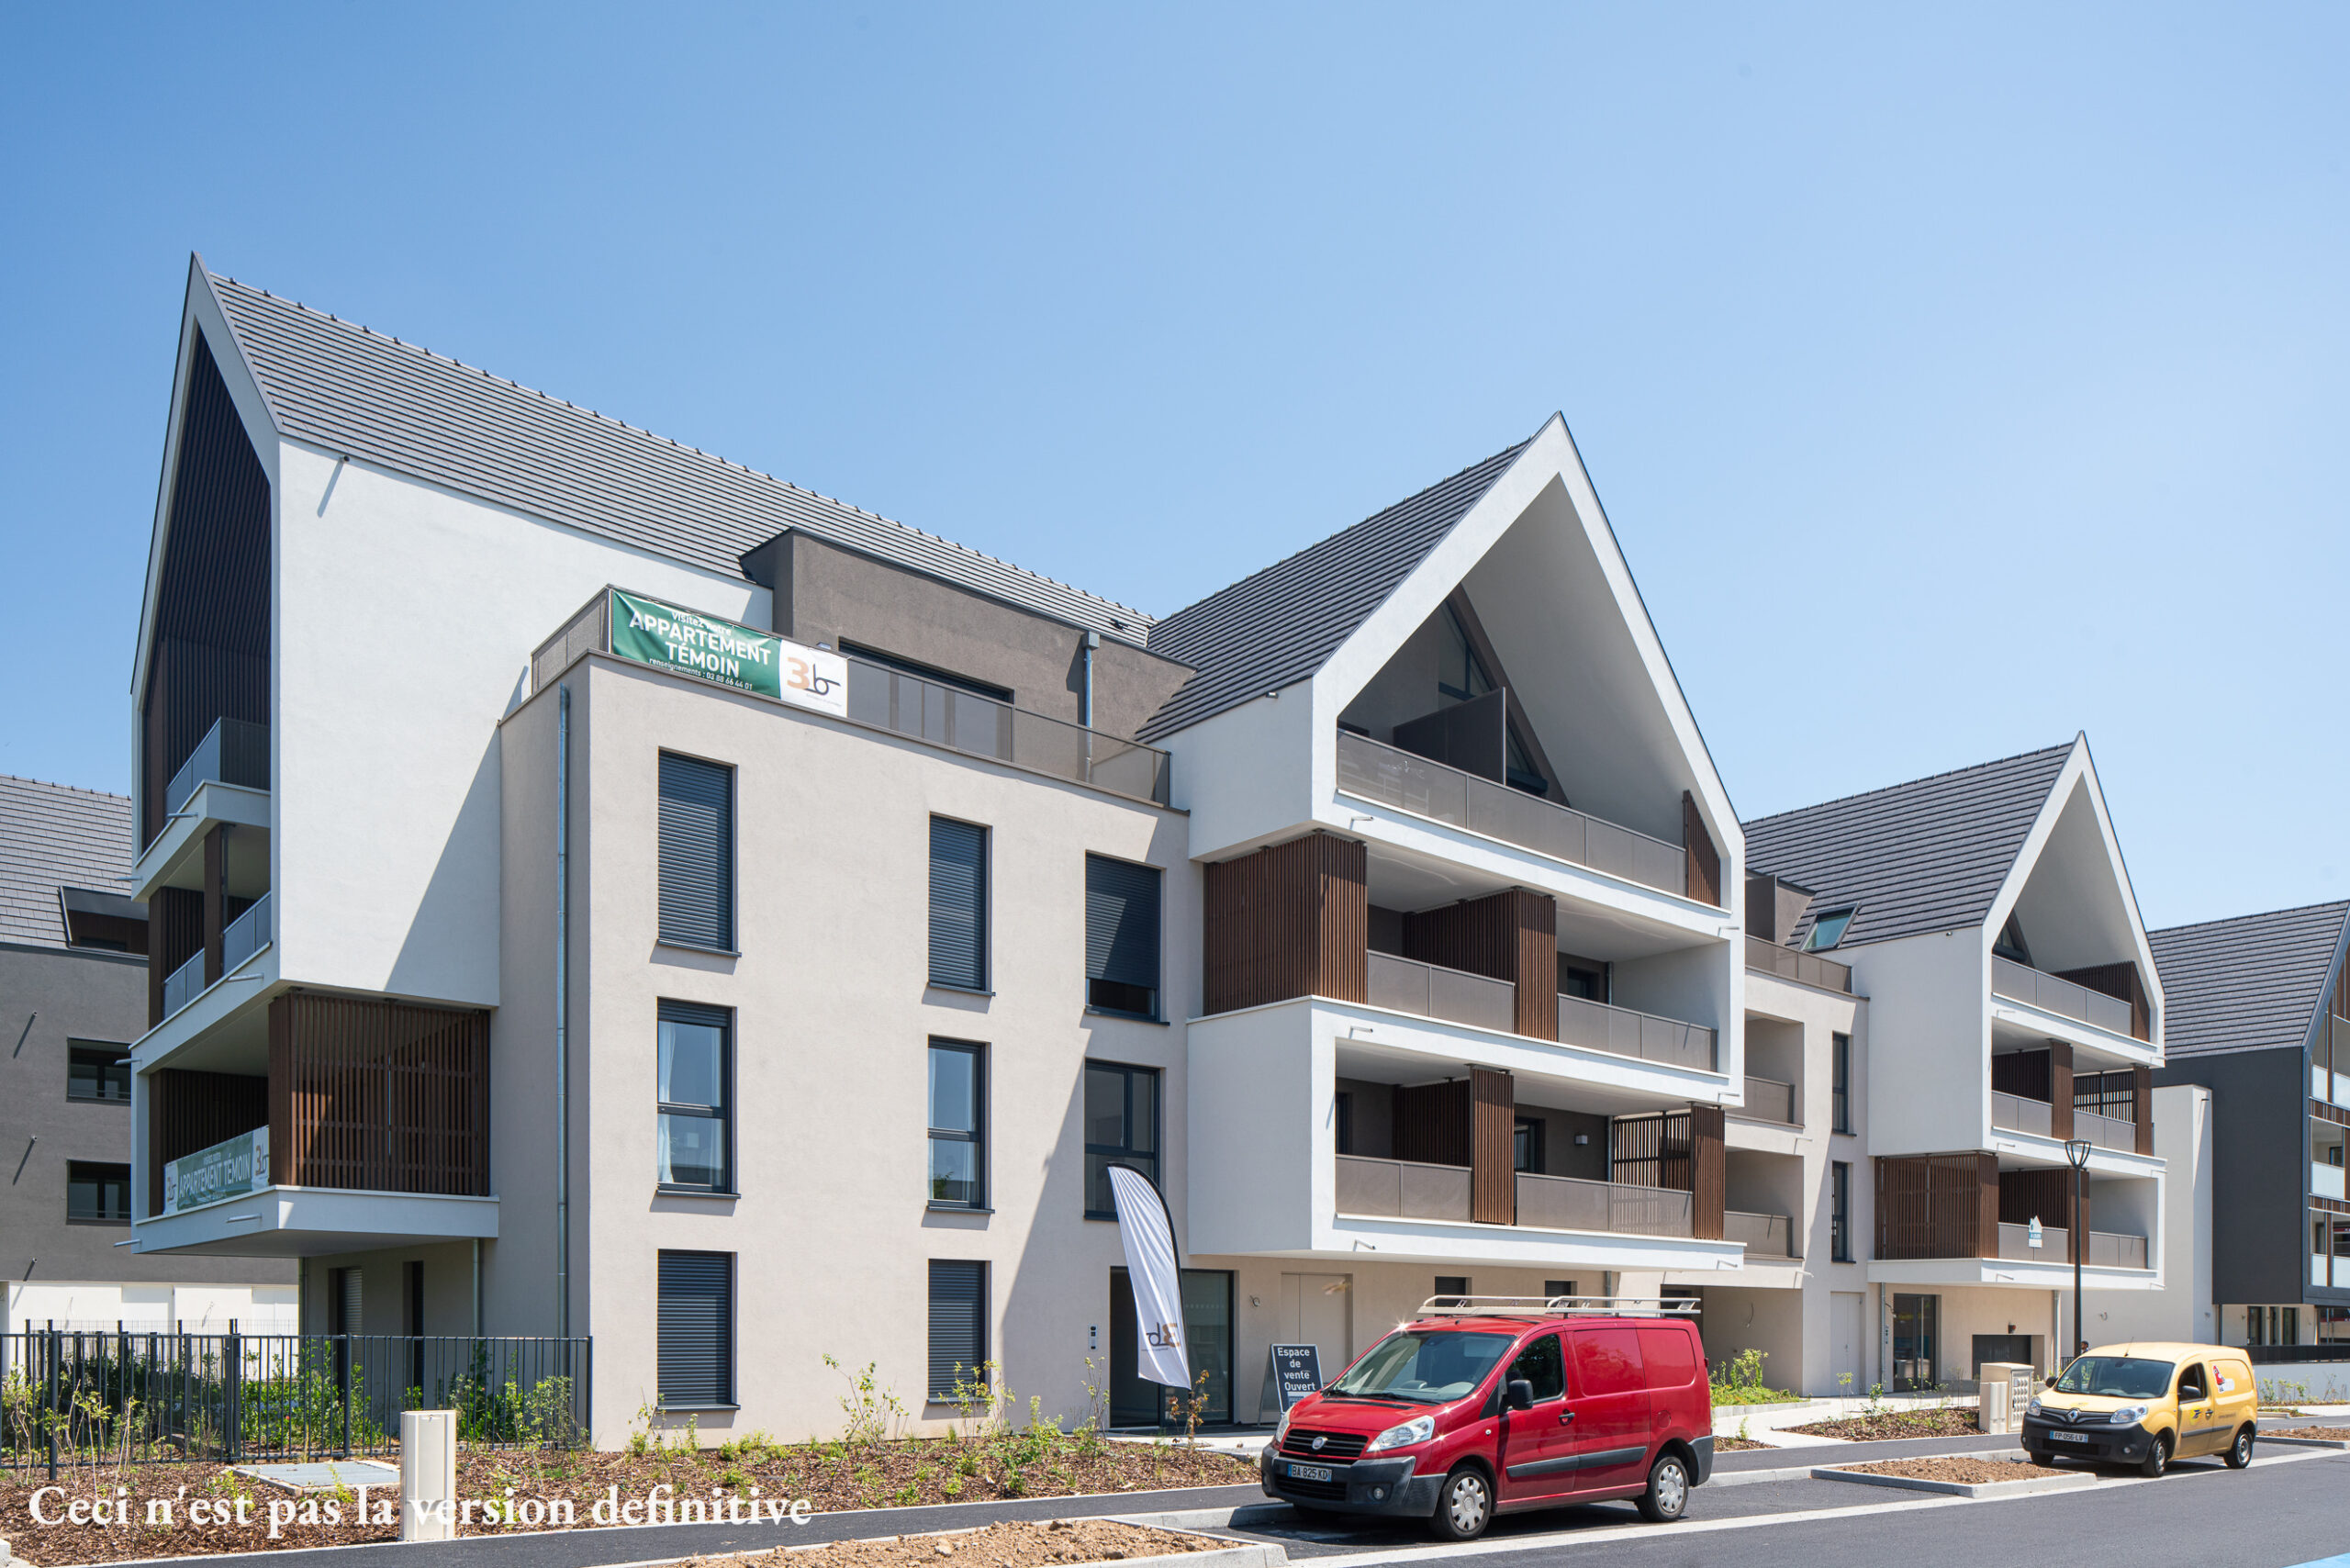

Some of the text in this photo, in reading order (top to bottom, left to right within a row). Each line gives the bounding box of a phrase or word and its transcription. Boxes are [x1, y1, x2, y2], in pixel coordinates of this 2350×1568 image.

[629, 610, 772, 666] APPARTEMENT
[665, 641, 740, 678] TÉMOIN
[649, 658, 701, 677] renseignements
[706, 672, 715, 680] 03
[725, 678, 734, 686] 66
[734, 680, 744, 689] 44
[744, 683, 753, 691] 01
[178, 1162, 222, 1198] APPARTEMENT
[223, 1152, 251, 1186] TÉMOIN
[1277, 1347, 1310, 1358] Espace
[1290, 1359, 1301, 1368] de
[1284, 1370, 1310, 1379] vente
[1284, 1382, 1316, 1391] Ouvert
